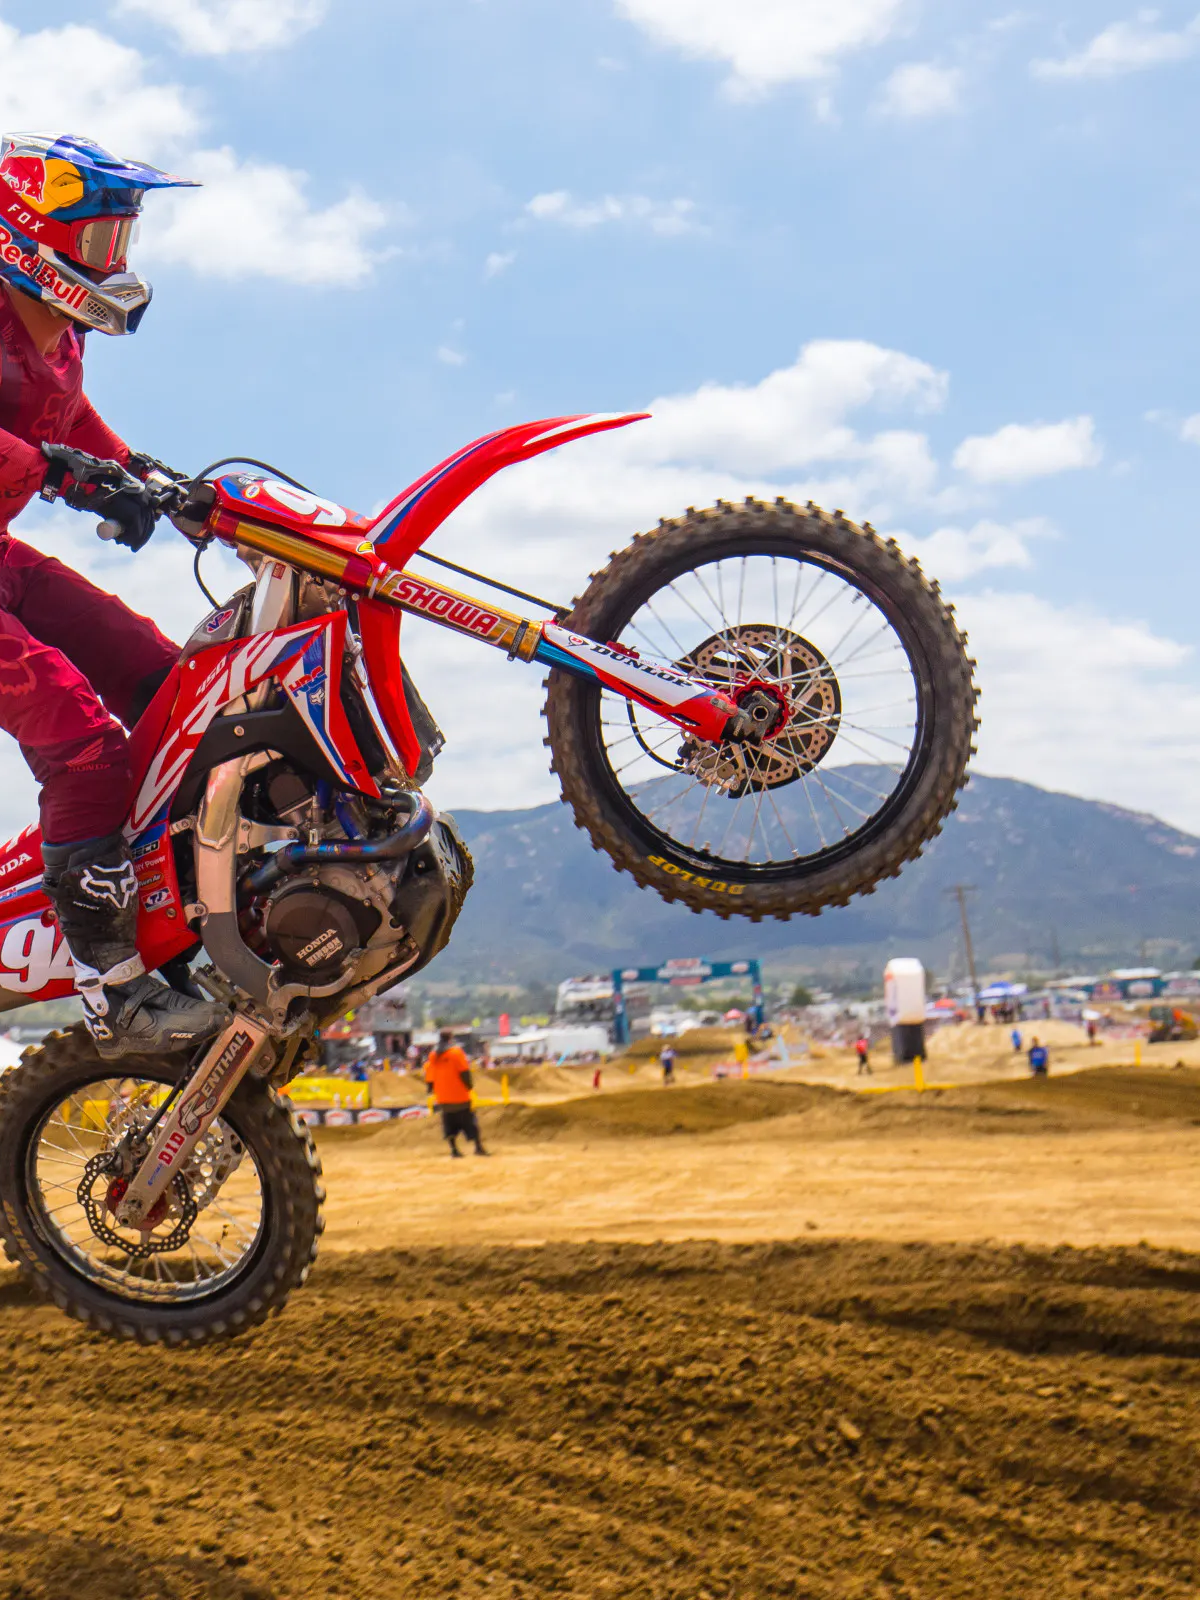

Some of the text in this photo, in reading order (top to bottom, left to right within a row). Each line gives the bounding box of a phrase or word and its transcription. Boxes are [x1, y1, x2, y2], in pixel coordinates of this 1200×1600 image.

[7, 203, 45, 233] FOX
[36, 261, 91, 311] Bull
[388, 578, 501, 637] SHOWA
[196, 654, 227, 697] 450
[590, 644, 693, 688] DUNLOP
[144, 856, 166, 869] Power
[647, 855, 746, 895] DUNLOP
[296, 929, 337, 960] HONDA
[157, 1131, 185, 1166] DID
